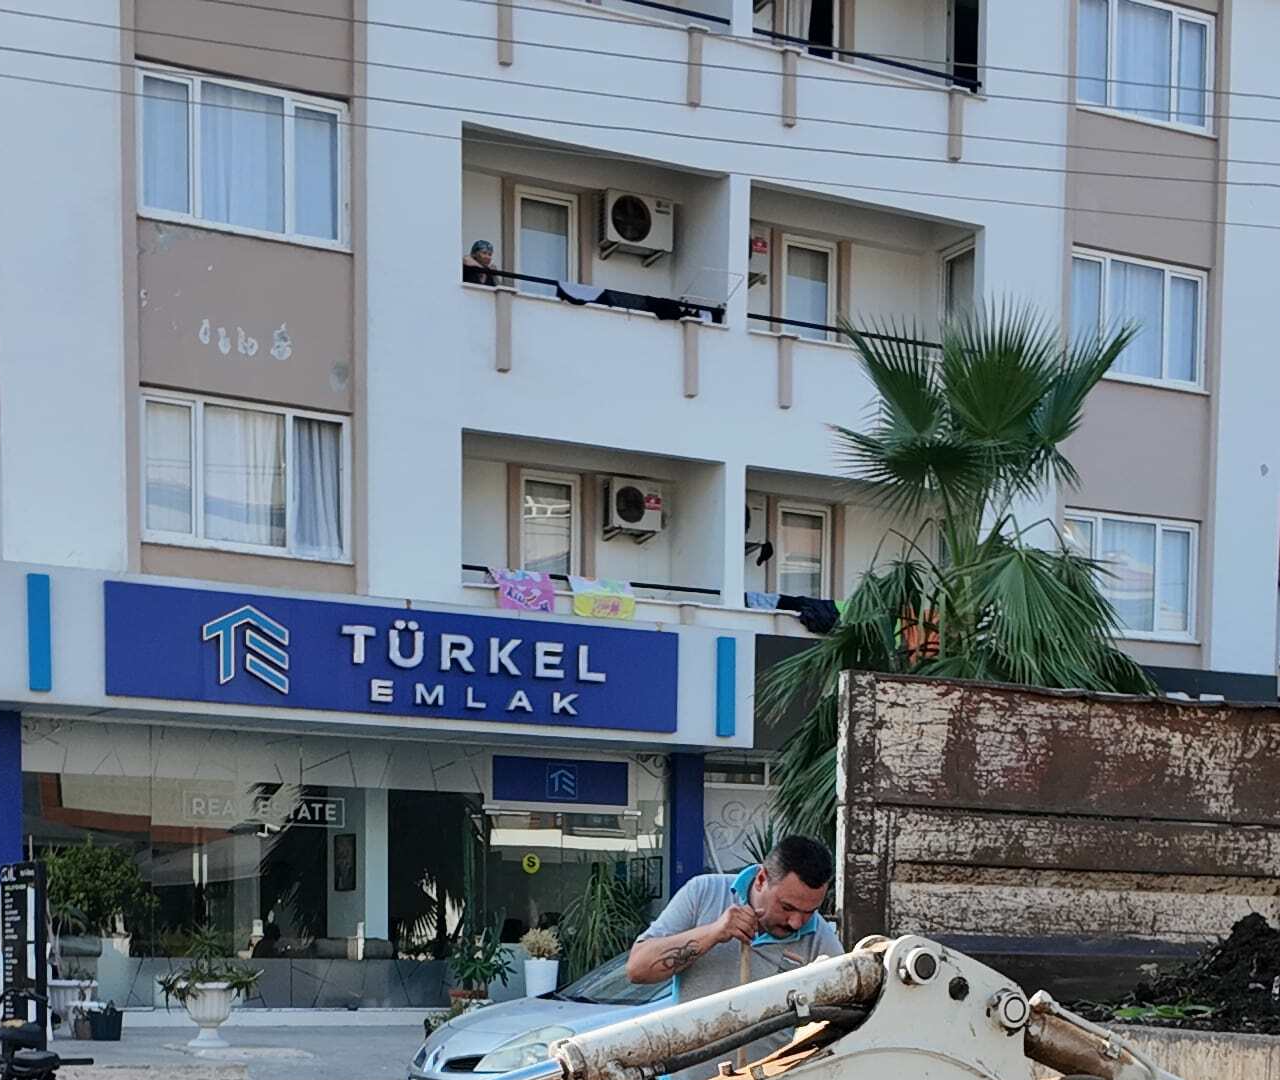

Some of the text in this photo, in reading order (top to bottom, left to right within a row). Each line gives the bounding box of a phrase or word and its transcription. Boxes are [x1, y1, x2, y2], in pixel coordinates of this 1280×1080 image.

[341, 618, 607, 683] TÜRKEL
[370, 678, 579, 716] EMLAK
[192, 798, 234, 817] REA
